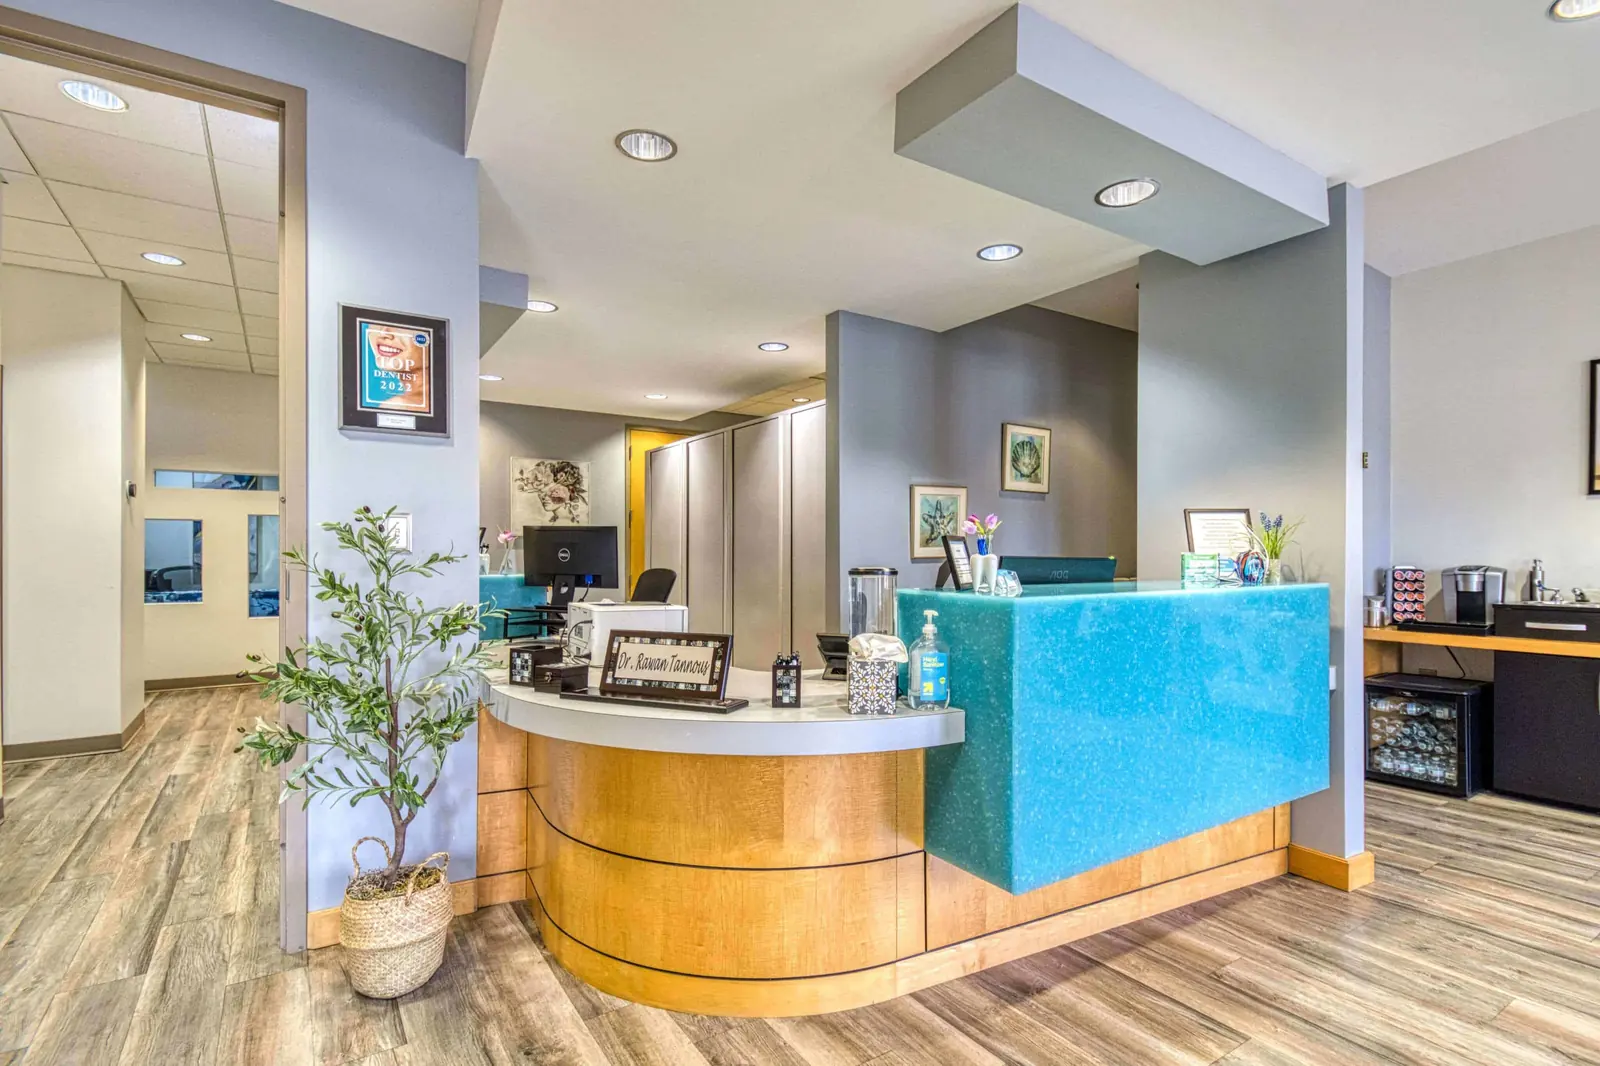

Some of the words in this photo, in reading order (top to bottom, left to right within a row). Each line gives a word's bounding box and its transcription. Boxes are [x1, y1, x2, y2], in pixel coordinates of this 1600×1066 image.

[376, 356, 415, 371] TOP
[373, 369, 418, 382] DENTIST
[380, 380, 412, 392] 2022
[635, 652, 669, 672] Rawan
[668, 653, 710, 676] Tannous
